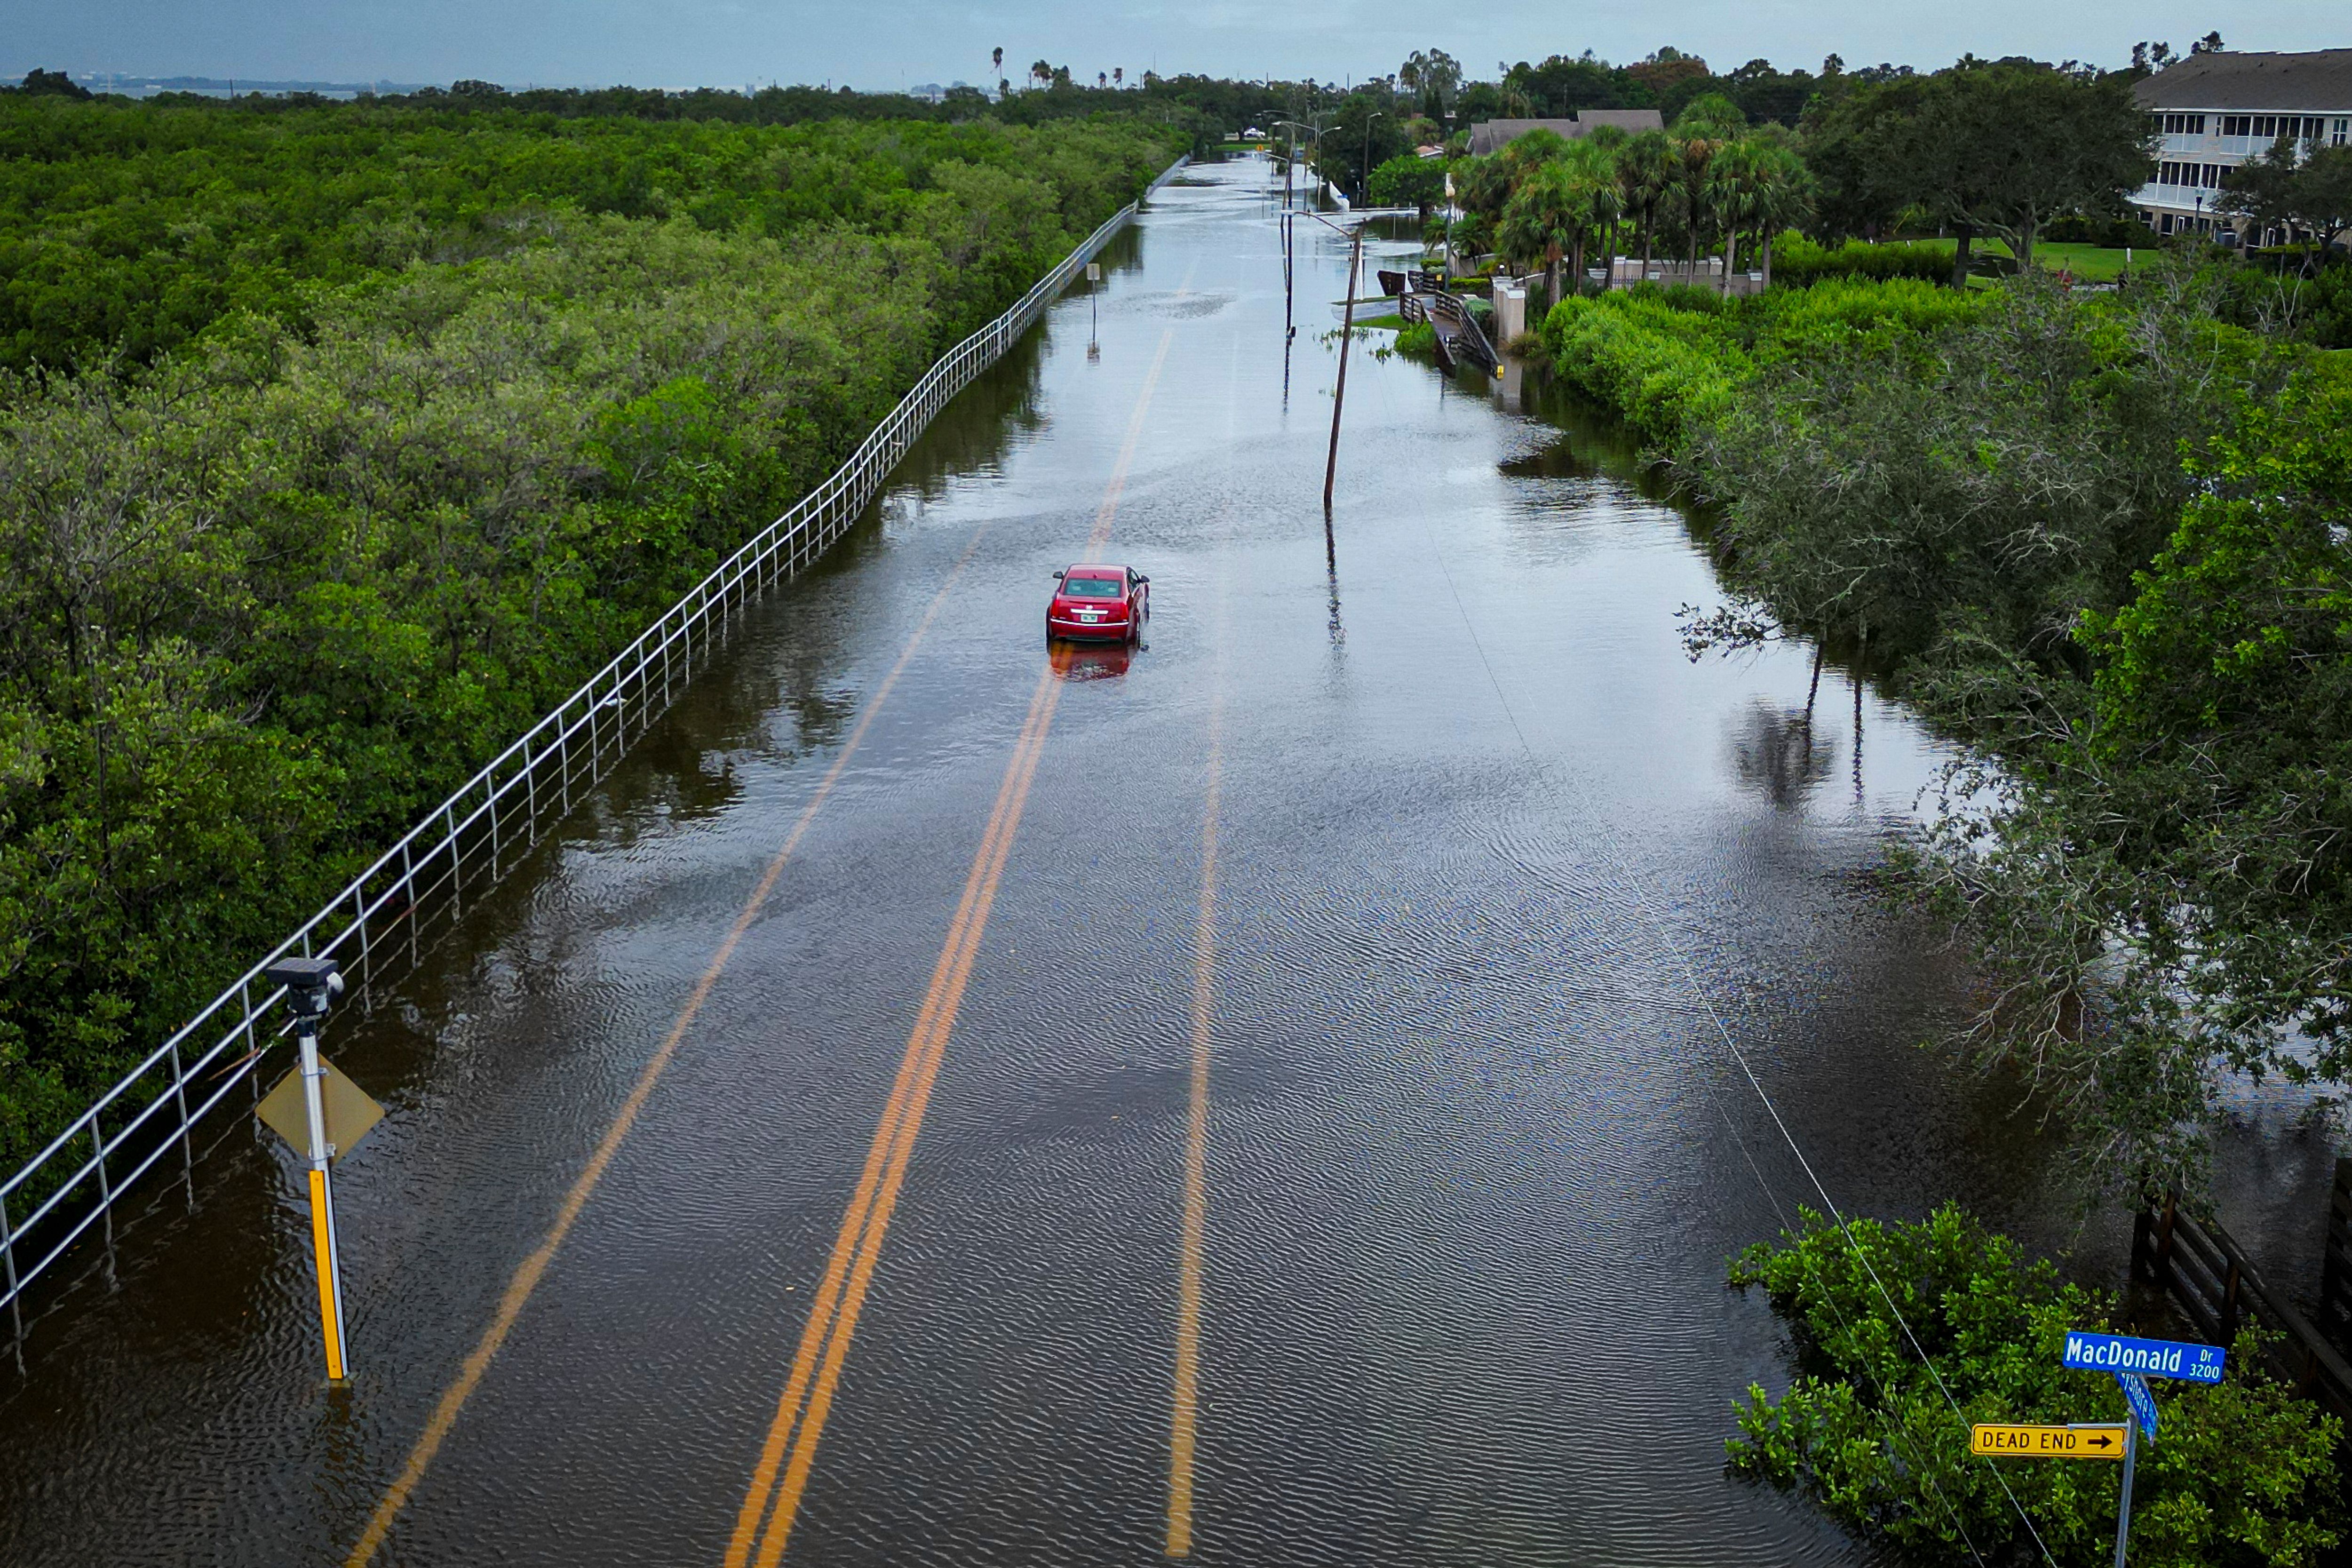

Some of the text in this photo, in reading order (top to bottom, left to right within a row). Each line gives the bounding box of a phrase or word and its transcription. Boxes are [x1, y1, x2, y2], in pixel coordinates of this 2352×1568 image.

[2066, 1337, 2213, 1372] MacDonald Dr
[2189, 1363, 2219, 1379] 3200
[1983, 1432, 2076, 1449] DEAD END
